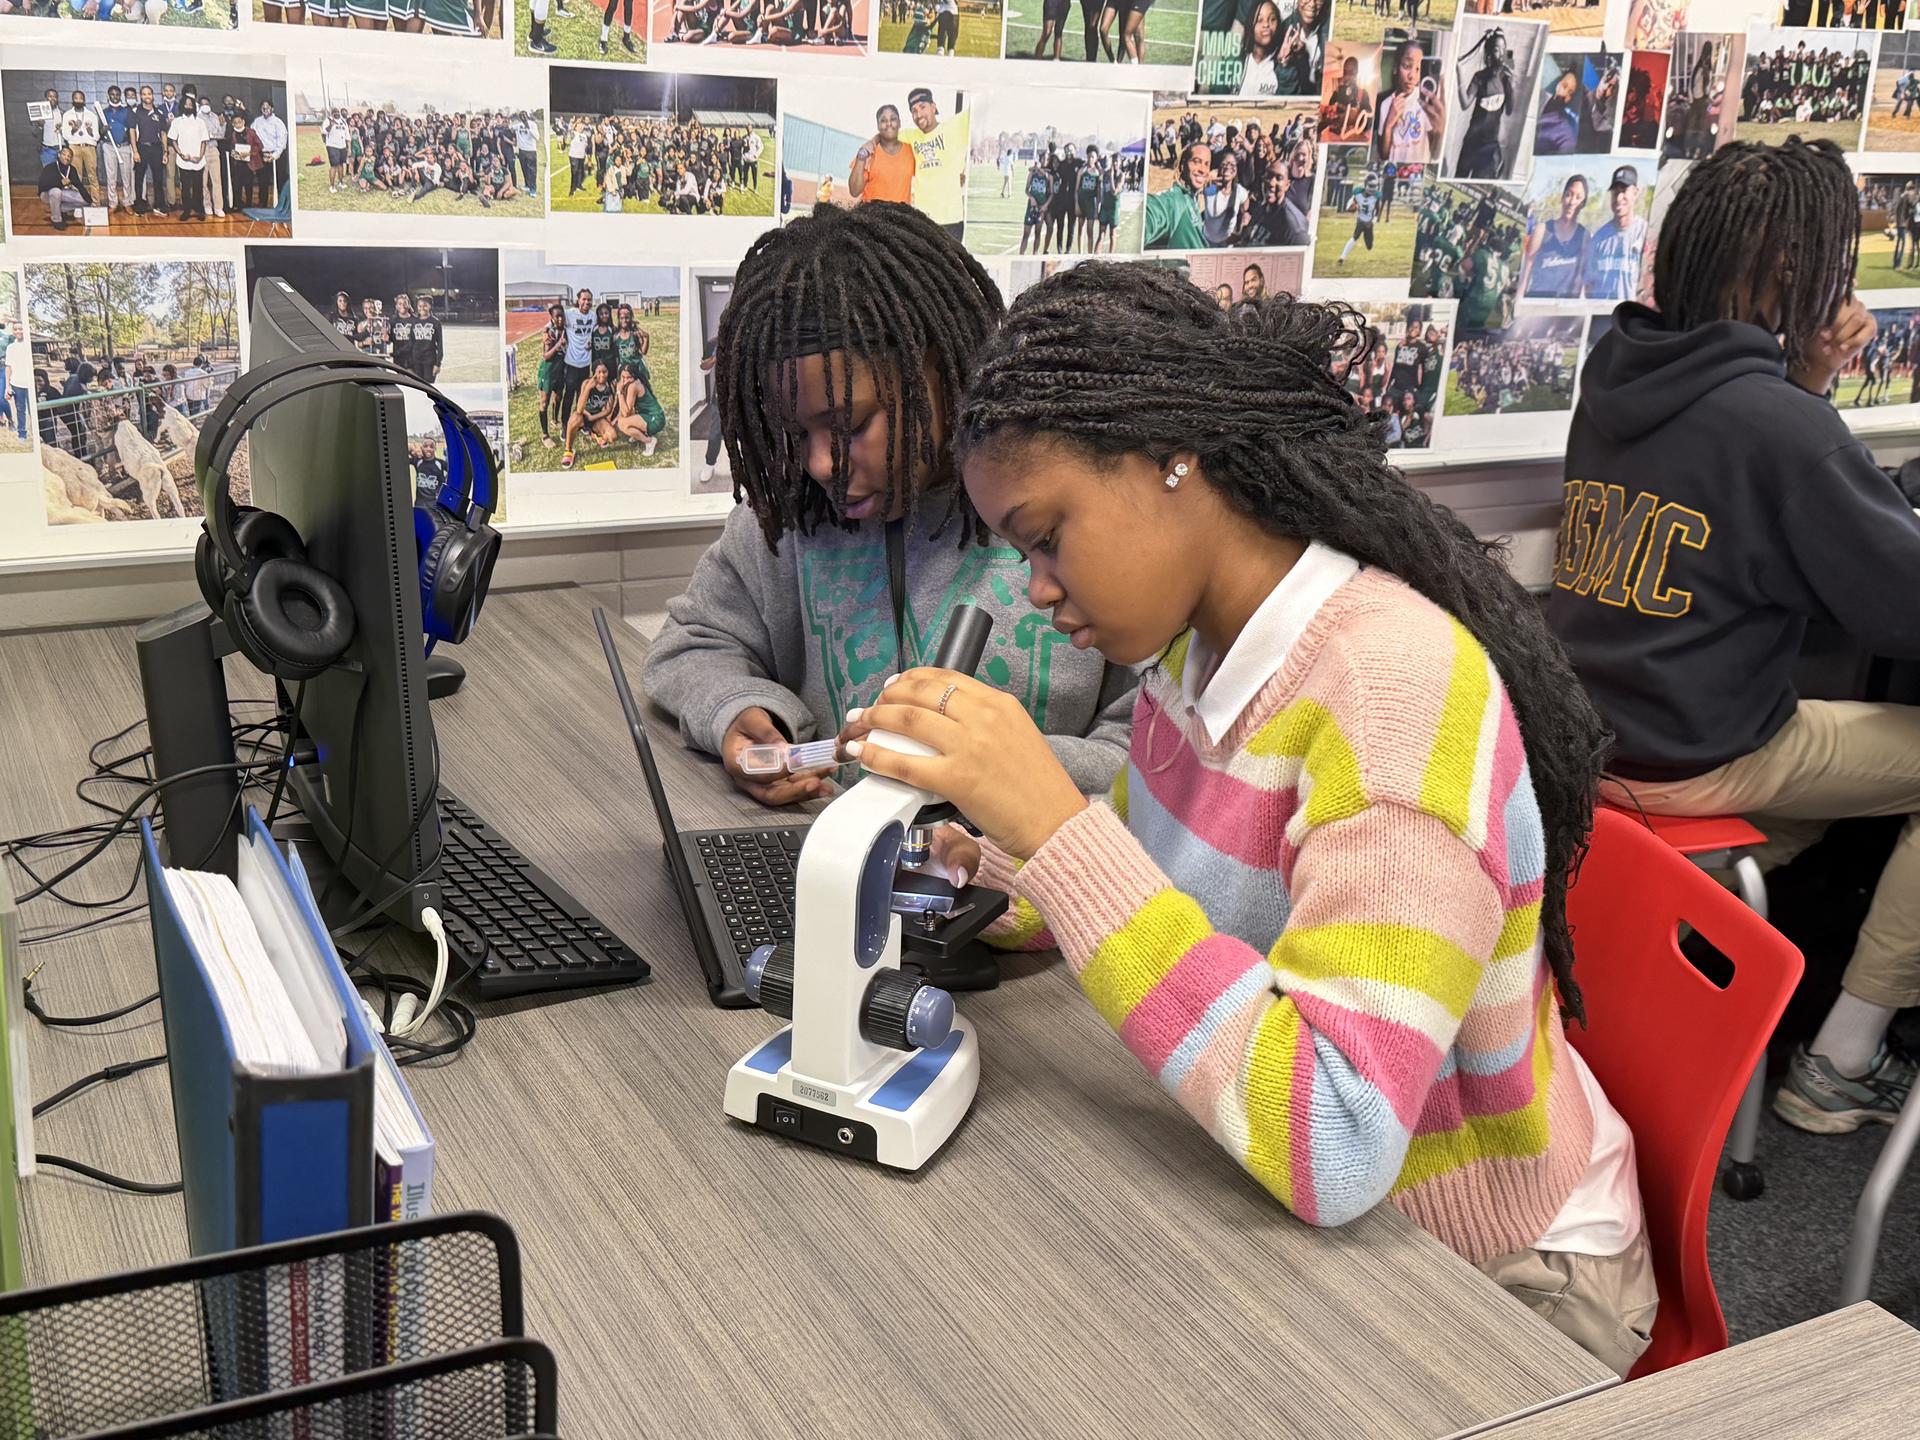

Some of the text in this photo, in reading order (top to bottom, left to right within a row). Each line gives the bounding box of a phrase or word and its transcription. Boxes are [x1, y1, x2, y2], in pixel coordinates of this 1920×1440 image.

[1202, 30, 1241, 58] MMS
[1197, 60, 1243, 86] CHEER
[799, 1085, 829, 1101] 2077562
